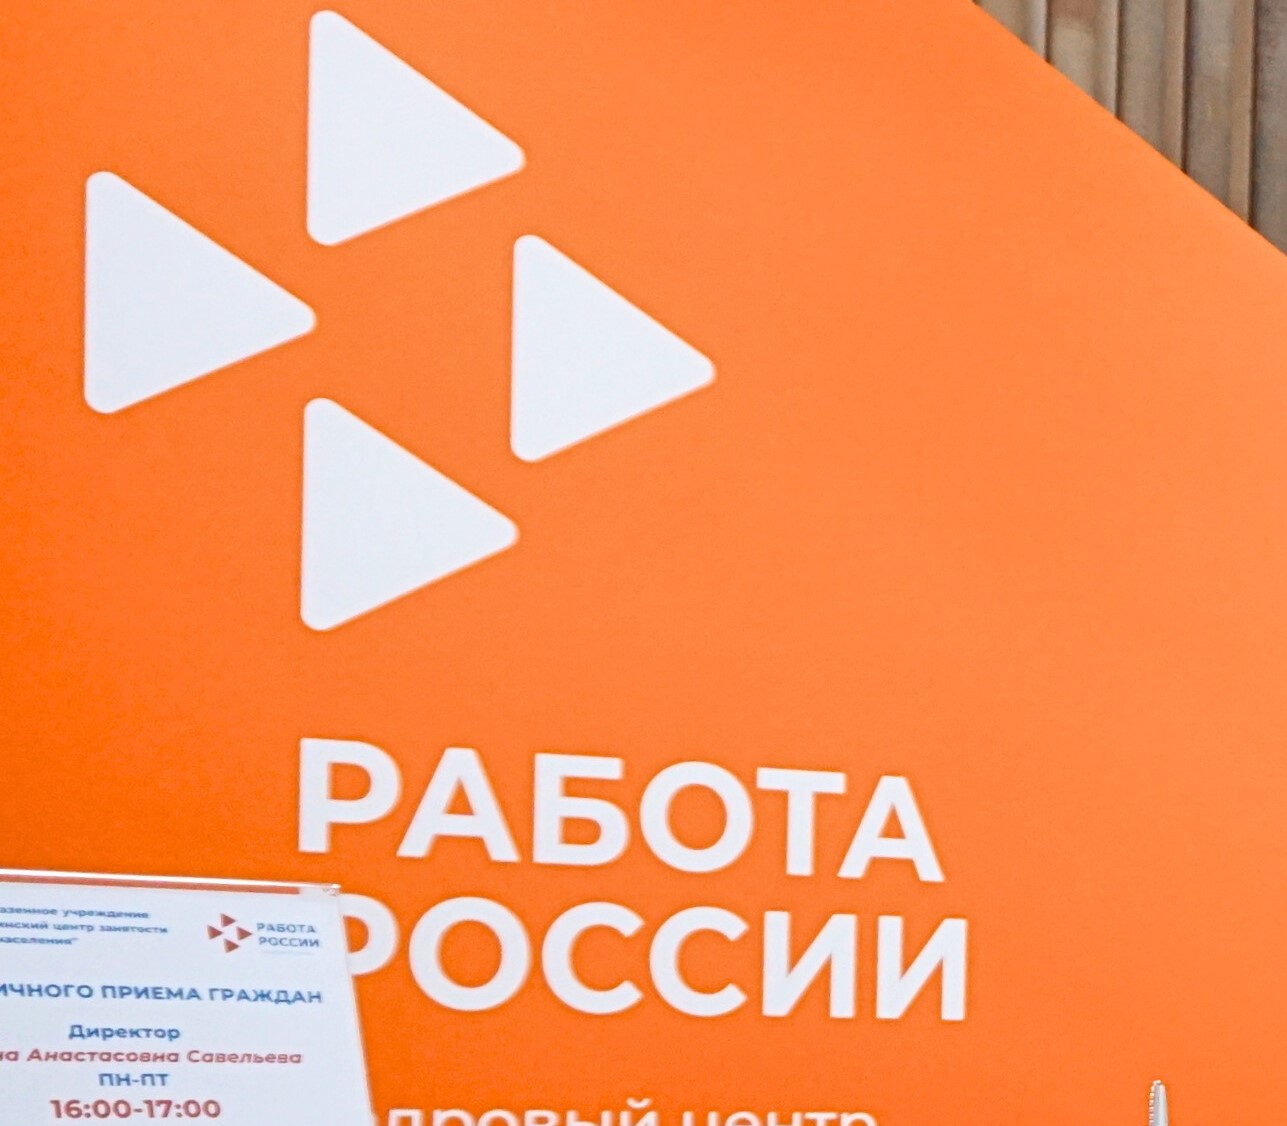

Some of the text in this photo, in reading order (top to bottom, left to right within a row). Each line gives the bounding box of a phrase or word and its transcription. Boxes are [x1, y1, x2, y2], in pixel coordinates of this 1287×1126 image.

[297, 737, 945, 883] РАБОТА
[63, 908, 149, 919] учреждение
[53, 923, 95, 932] центр
[100, 925, 168, 934] занятости
[256, 922, 316, 933] РАБОТА
[258, 936, 320, 948] РОССИИ
[101, 985, 201, 1000] ПРИЕМА
[209, 987, 323, 1004] ГРАЖДАН
[68, 1024, 181, 1041] Директор
[26, 1048, 180, 1063] Анастасовна
[187, 1049, 303, 1064] Савельева
[98, 1073, 170, 1087] ПН-ПТ
[50, 1099, 221, 1119] 16:00-17:00
